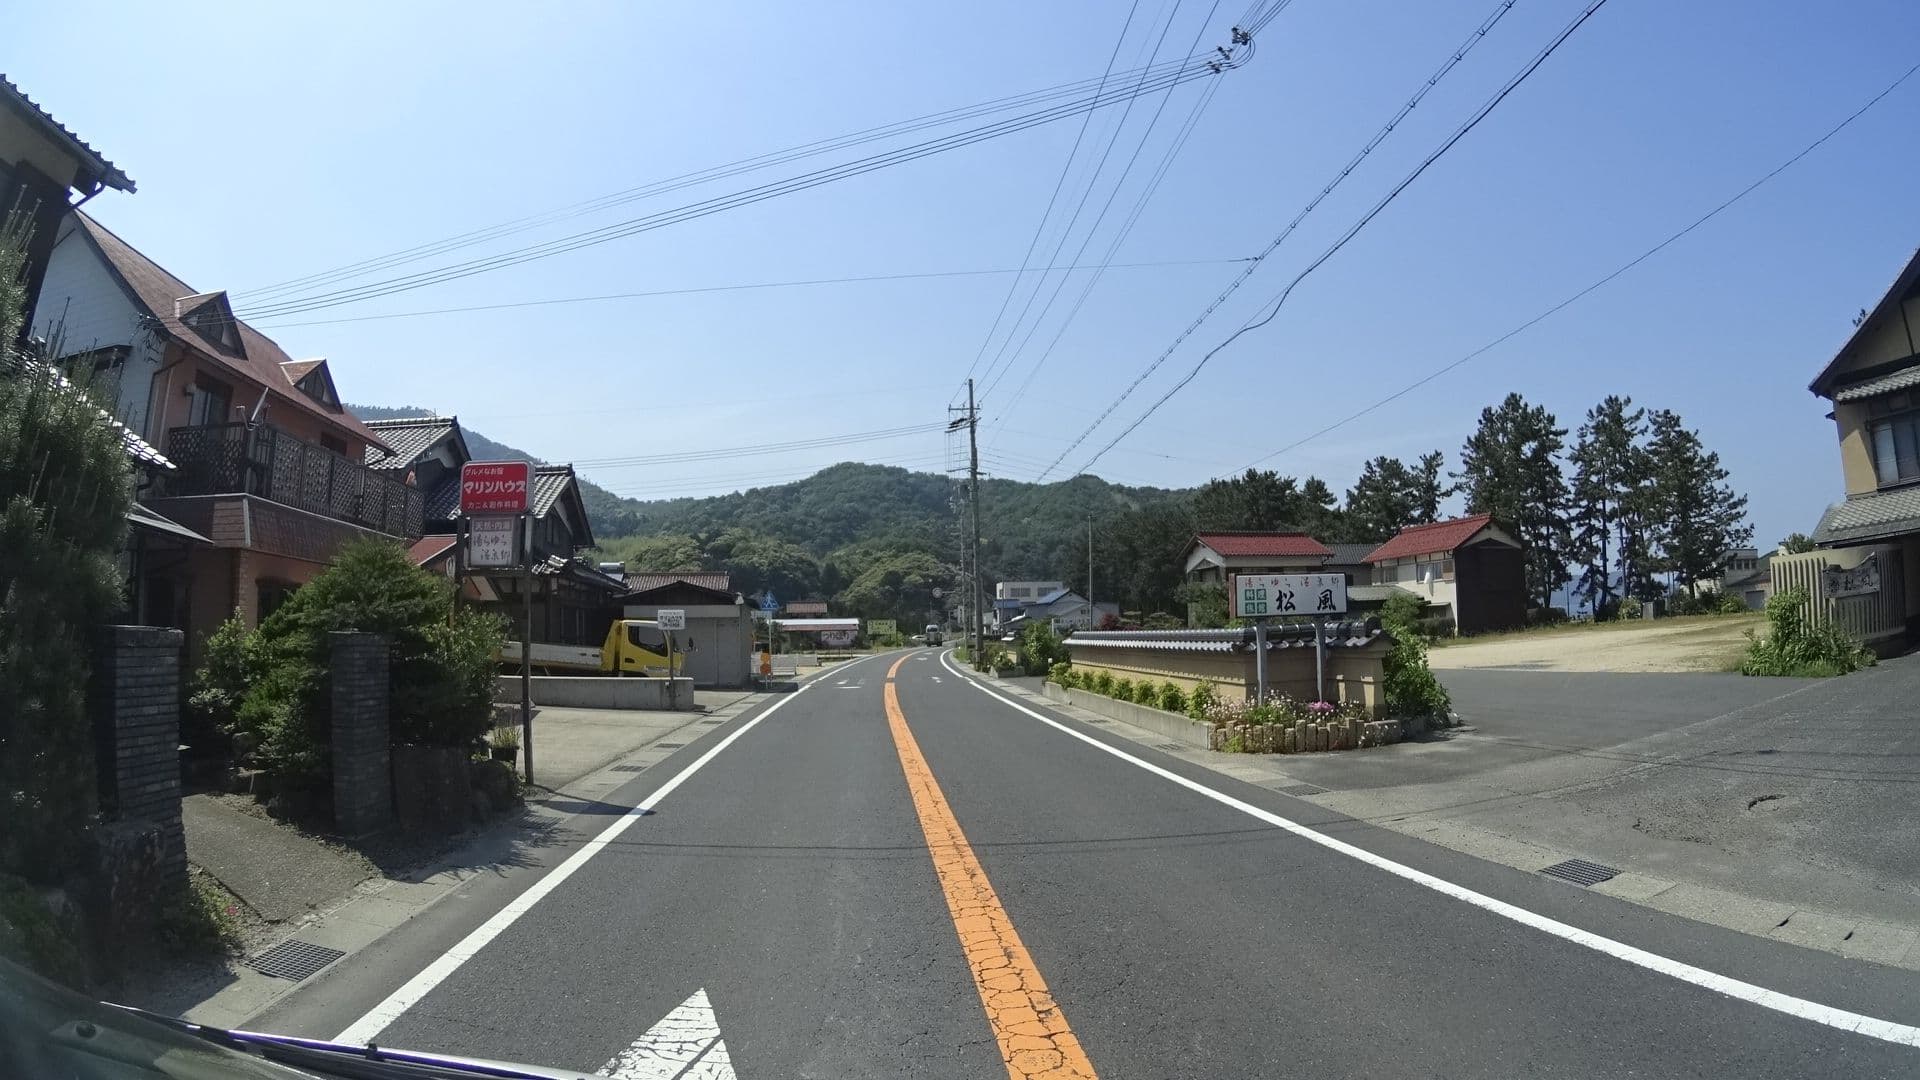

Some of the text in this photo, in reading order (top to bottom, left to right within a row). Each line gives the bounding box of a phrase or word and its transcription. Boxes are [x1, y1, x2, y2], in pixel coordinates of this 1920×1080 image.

[464, 480, 526, 494] マリンハウス
[1276, 588, 1337, 612] 松風
